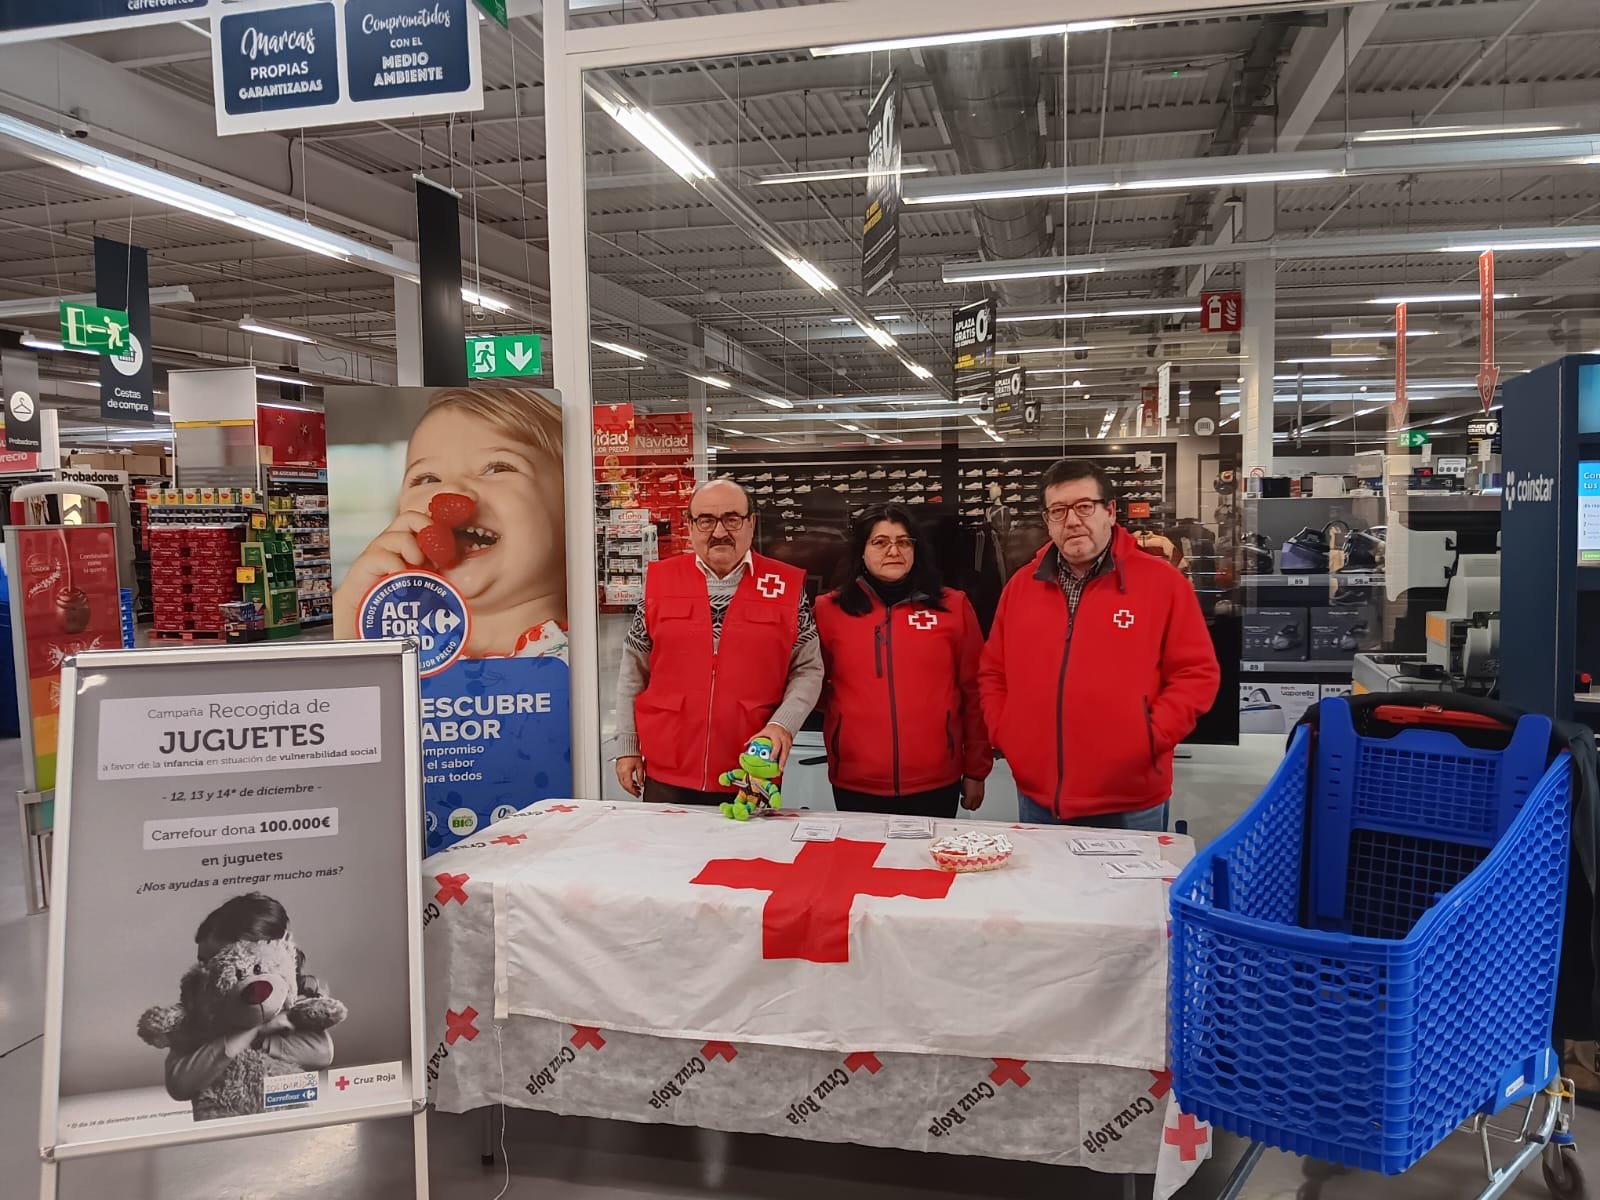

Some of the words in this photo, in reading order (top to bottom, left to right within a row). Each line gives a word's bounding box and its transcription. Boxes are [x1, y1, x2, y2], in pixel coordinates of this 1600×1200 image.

[362, 3, 451, 34] Comprometidos
[241, 27, 316, 60] Marcas
[390, 38, 410, 49] CON
[412, 37, 423, 46] EL
[250, 61, 309, 80] PROPIAS
[382, 51, 429, 70] MEDIO
[373, 66, 443, 87] AMBIENTE
[238, 79, 323, 100] GARANTIZADAS
[954, 317, 975, 332] APLAZA
[954, 327, 976, 343] GRATIS
[114, 387, 142, 400] Cestas
[107, 398, 119, 409] de
[119, 401, 149, 412] compra
[8, 437, 40, 447] Probadores
[635, 433, 689, 449] Navidad
[61, 471, 119, 483] Probadores
[1517, 472, 1554, 502] coinstar
[366, 606, 377, 629] TODOS
[373, 579, 411, 606] MERECEMOS
[424, 581, 448, 598] MEJOR
[381, 601, 421, 619] ACT
[381, 619, 419, 636] FOR
[435, 641, 457, 662] PRECIO
[147, 707, 204, 720] Campaña
[209, 700, 301, 720] Recogida
[306, 698, 330, 714] de
[420, 692, 551, 718] ESCUBRE
[159, 723, 325, 754] JUGUETES
[421, 719, 501, 742] ABOR
[111, 762, 135, 771] favor
[137, 761, 150, 769] de
[153, 760, 160, 768] la
[163, 759, 203, 768] infancia
[206, 758, 218, 766] en
[220, 755, 263, 765] situación
[265, 754, 277, 762] de
[280, 749, 348, 761] vulnerabilidad
[350, 747, 377, 756] social
[423, 743, 485, 757] mpromiso
[427, 760, 438, 769] el
[441, 758, 475, 769] sabor
[449, 771, 482, 782] todos
[170, 791, 187, 801] 12,
[191, 790, 204, 800] 13
[206, 792, 214, 802] y
[240, 787, 254, 797] de
[257, 784, 314, 796] diciembre
[151, 828, 217, 841] Carrefour
[221, 825, 255, 836] dona
[260, 816, 331, 833] 100.000€
[201, 857, 219, 866] en
[222, 851, 283, 867] juguetes
[136, 882, 166, 895] ¿Nos
[168, 878, 209, 891] ayudas
[212, 878, 219, 886] a
[222, 873, 271, 885] entregar
[273, 869, 313, 881] mucho
[315, 866, 344, 877] más?
[549, 1046, 576, 1073] Cruz
[353, 1075, 374, 1085] Cruz
[376, 1073, 396, 1083] Roja
[525, 1067, 556, 1095] Roja
[674, 1056, 706, 1087] Cruz
[649, 1080, 682, 1109] Roja
[813, 1068, 850, 1100] Cruz
[266, 1094, 300, 1104] Carrefour
[957, 1081, 995, 1112] Cruz
[786, 1095, 821, 1125] Roja
[1113, 1096, 1154, 1128] Cruz
[928, 1107, 966, 1138] Roja
[1082, 1122, 1122, 1154] Roja
